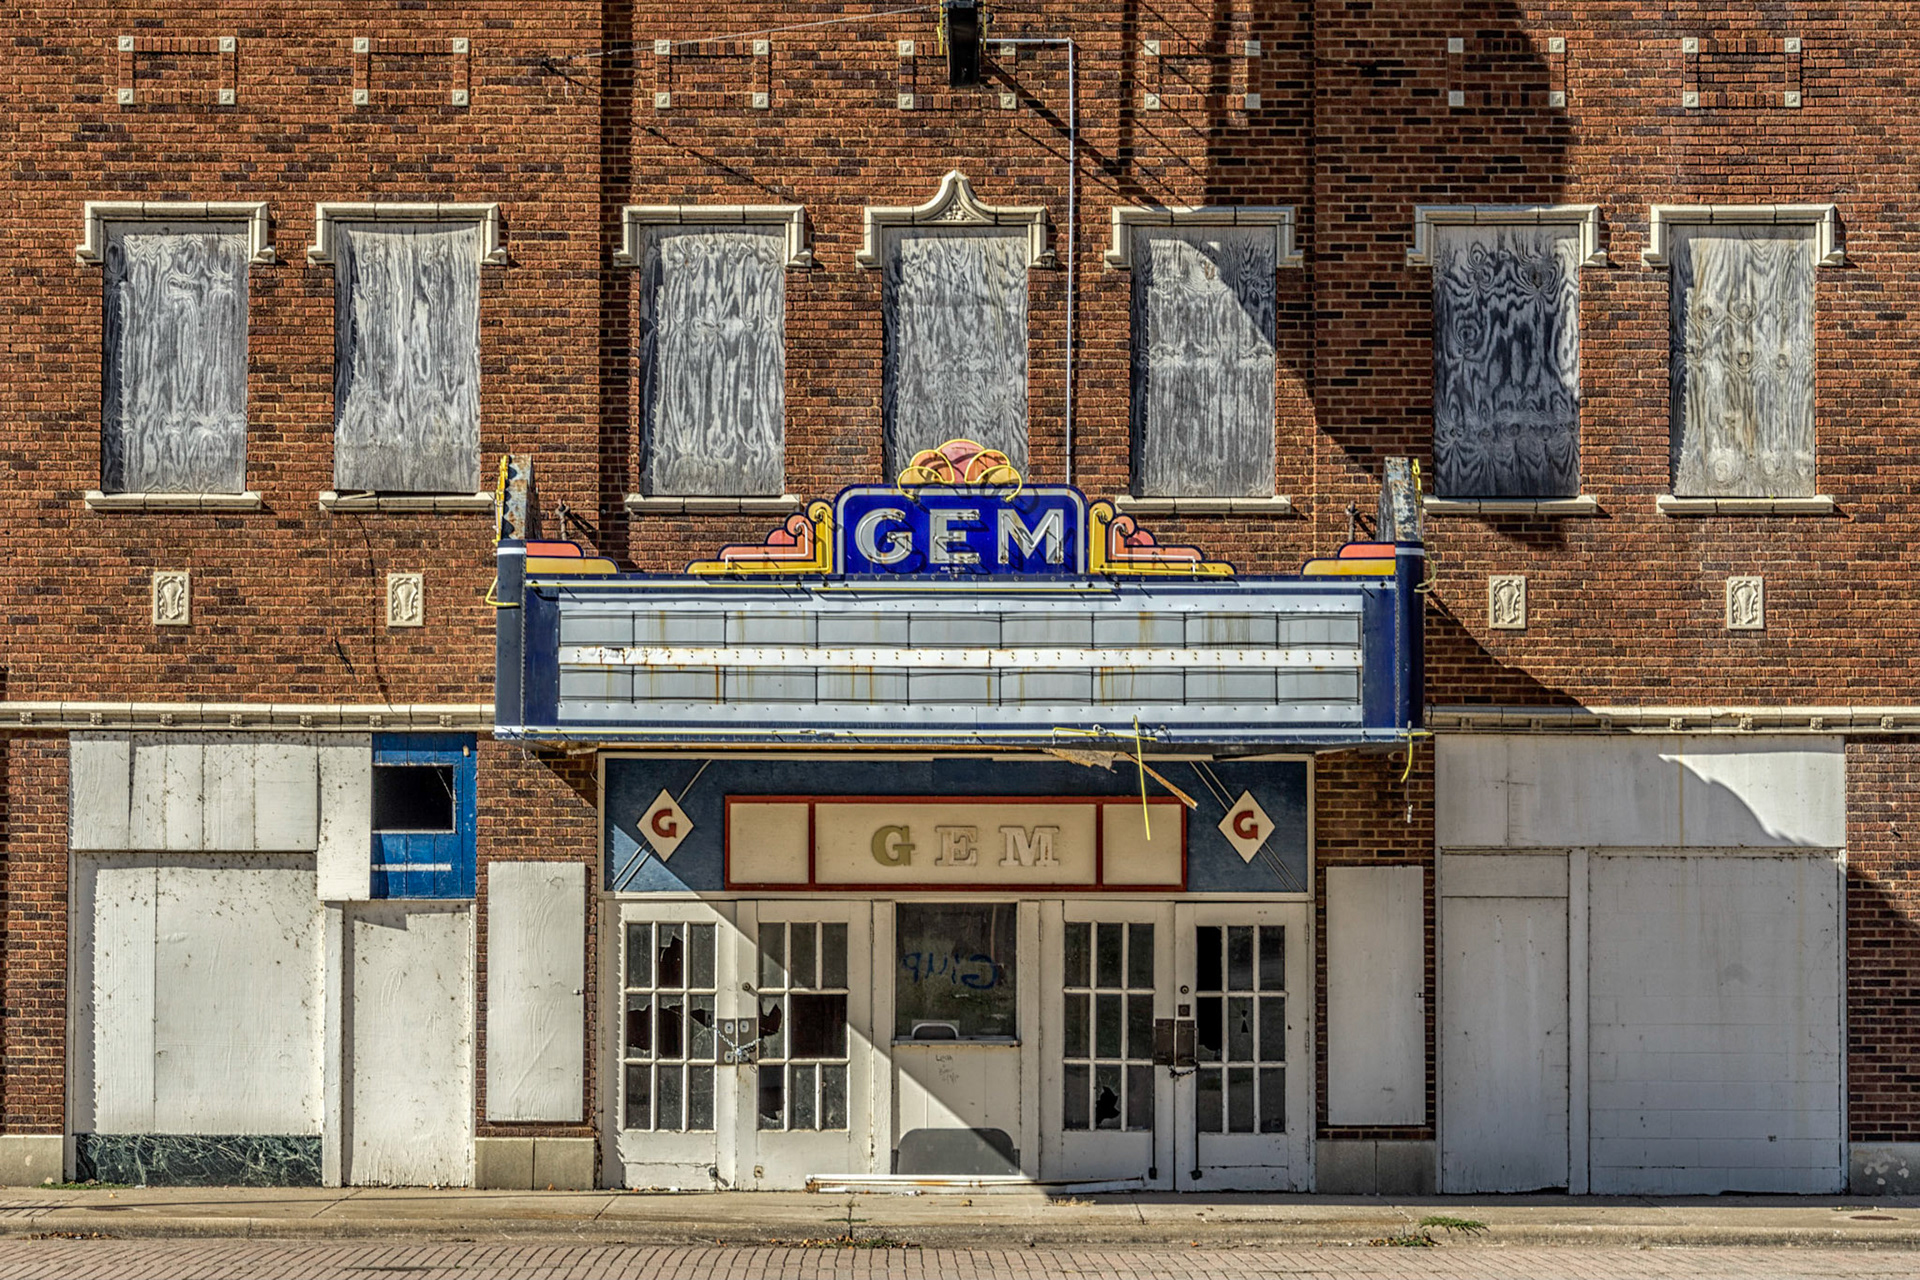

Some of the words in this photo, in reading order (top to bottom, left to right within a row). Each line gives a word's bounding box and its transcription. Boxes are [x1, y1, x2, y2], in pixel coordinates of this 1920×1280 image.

[854, 508, 1065, 565] GEM
[651, 808, 677, 839] G
[1233, 810, 1259, 840] G
[871, 825, 1060, 867] GEM
